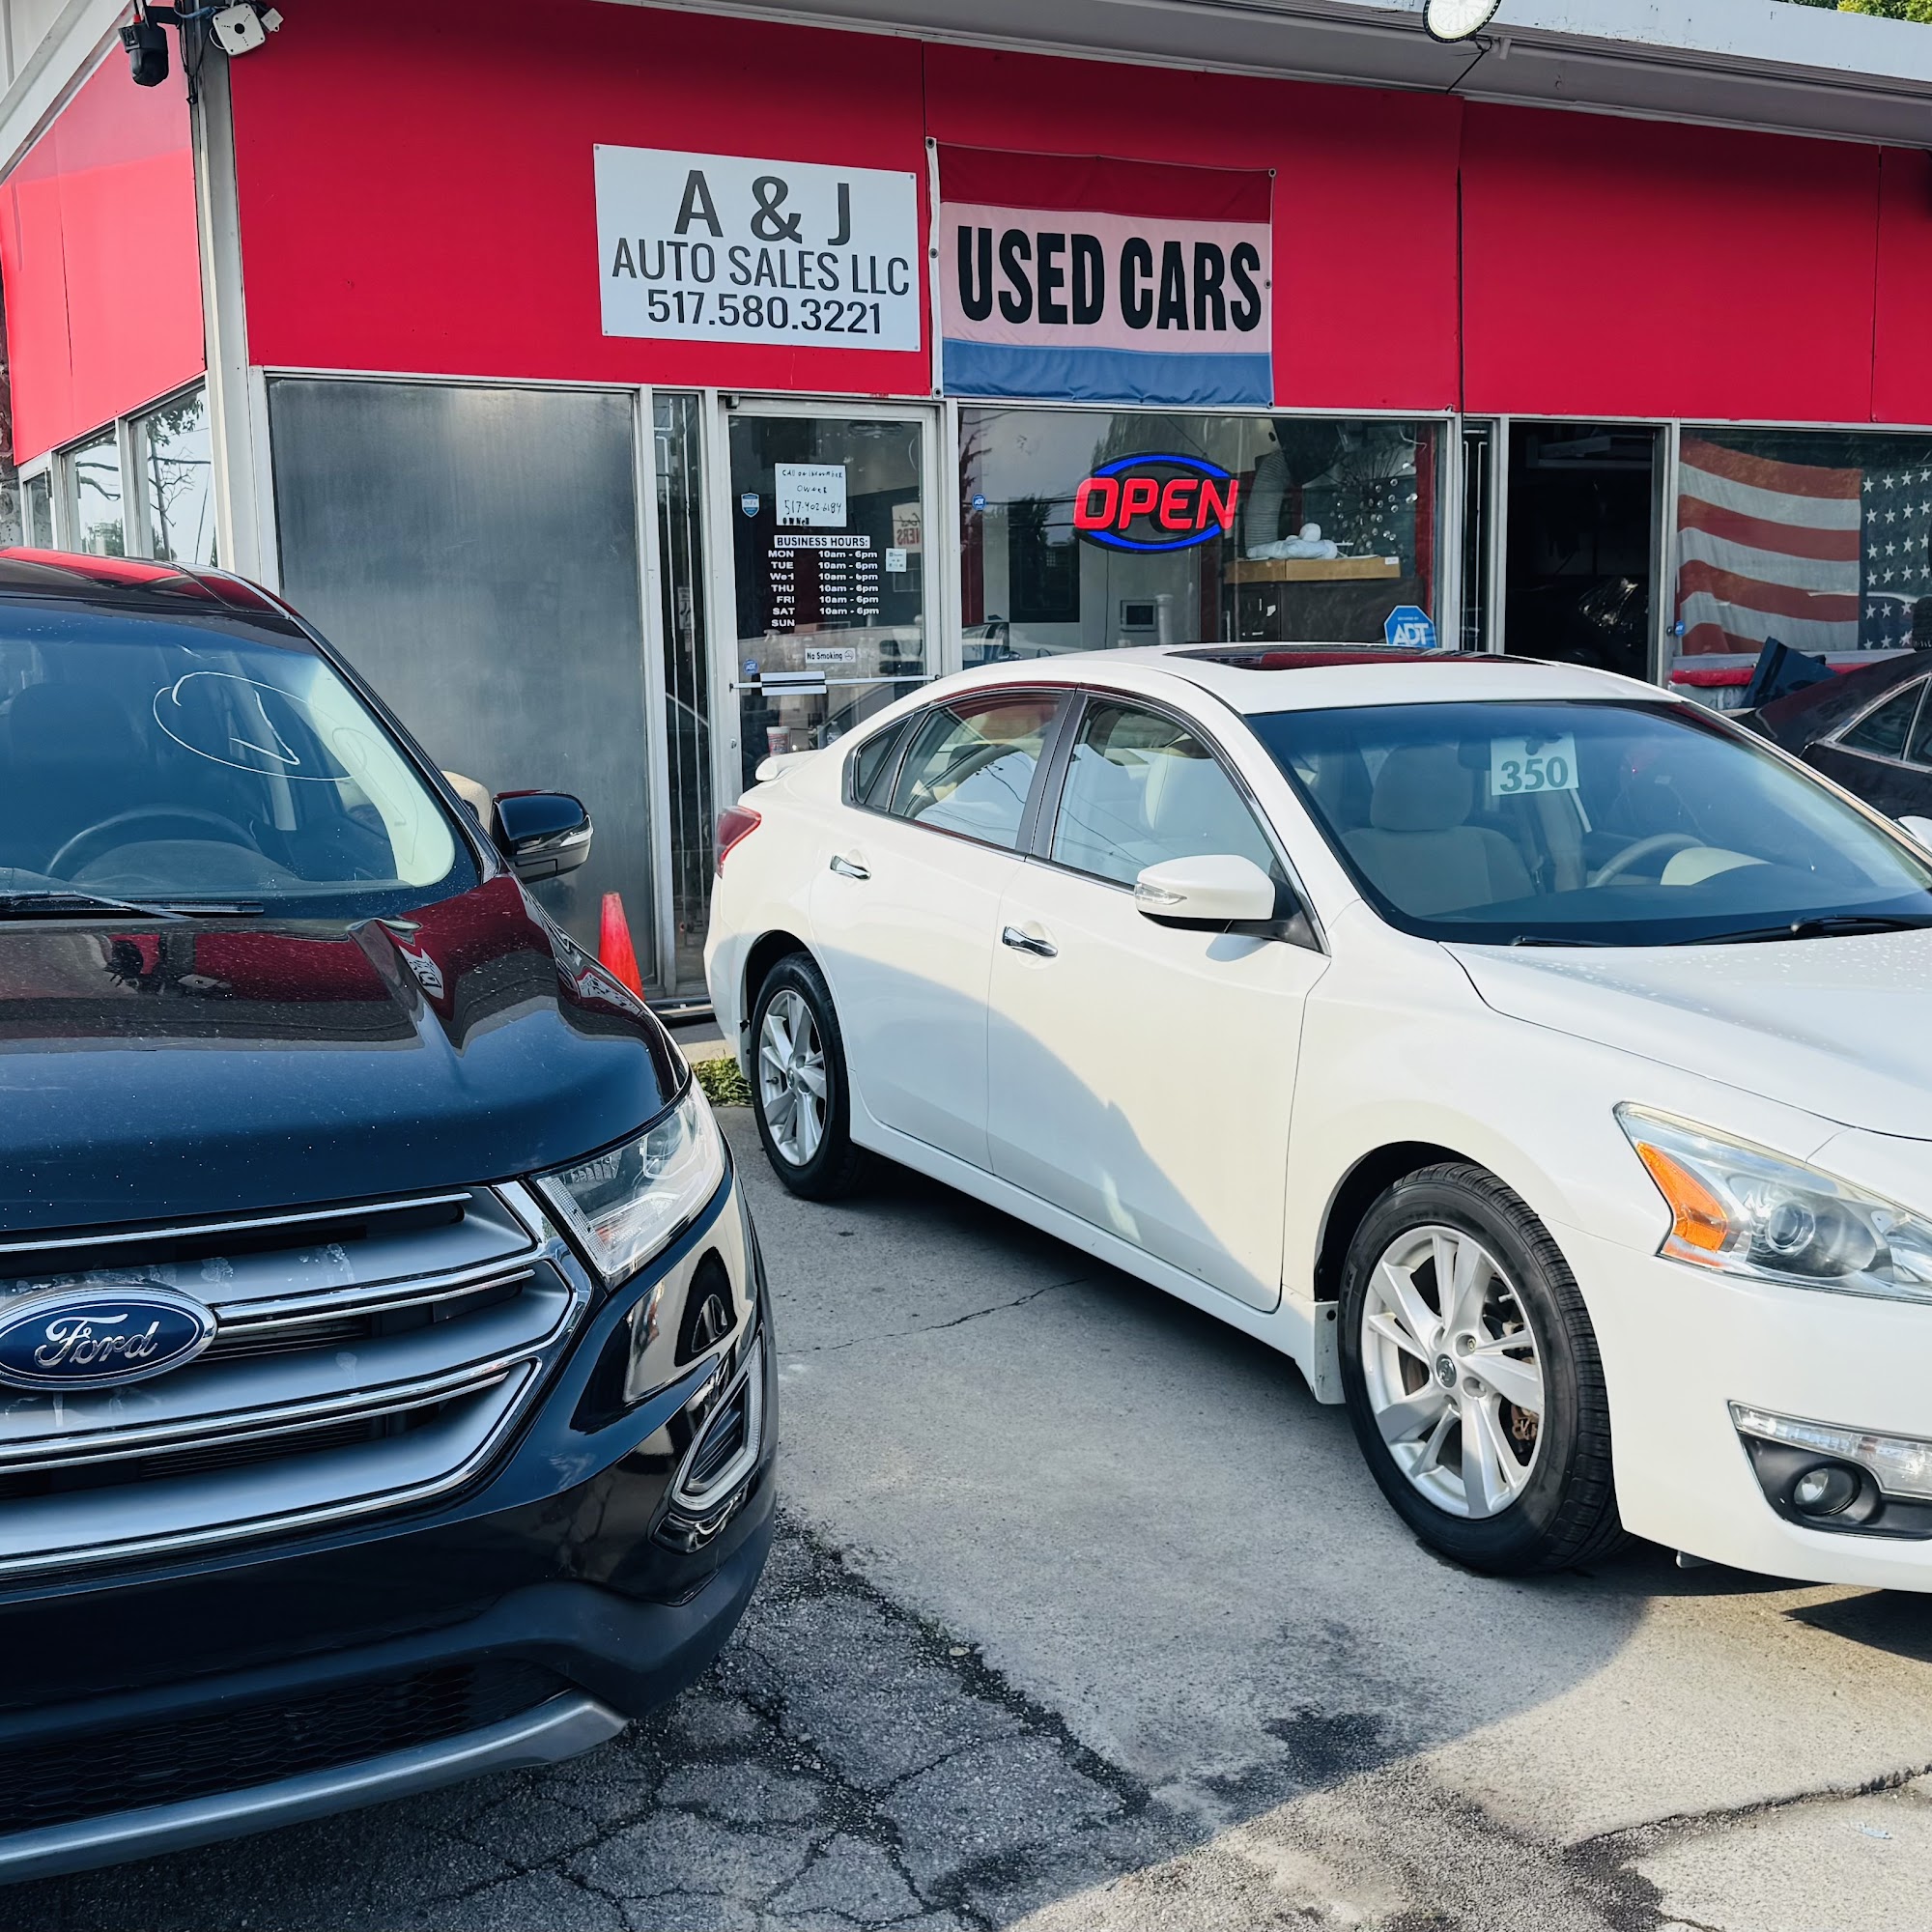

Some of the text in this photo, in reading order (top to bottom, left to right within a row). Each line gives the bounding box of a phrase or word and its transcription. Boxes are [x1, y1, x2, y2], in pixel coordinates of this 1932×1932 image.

[674, 169, 851, 246] A & J
[611, 237, 910, 296] AUTO SALES LLC
[957, 225, 1262, 332] USED CARS
[647, 288, 881, 334] 517.580.3221
[1073, 477, 1239, 530] OPEN
[777, 537, 868, 547] BUSINESS HOURS:
[768, 550, 794, 558] MON
[818, 550, 846, 558] 10am
[855, 550, 878, 559] 6pm
[855, 561, 878, 571] 6pm
[856, 584, 879, 593] 6pm
[819, 607, 847, 615] 10am
[856, 607, 879, 616] 6pm
[856, 596, 879, 605] 6pm
[1392, 622, 1429, 645] ADT
[816, 652, 842, 661] Smoking
[1500, 756, 1569, 792] 350
[34, 1313, 160, 1369] Ford
